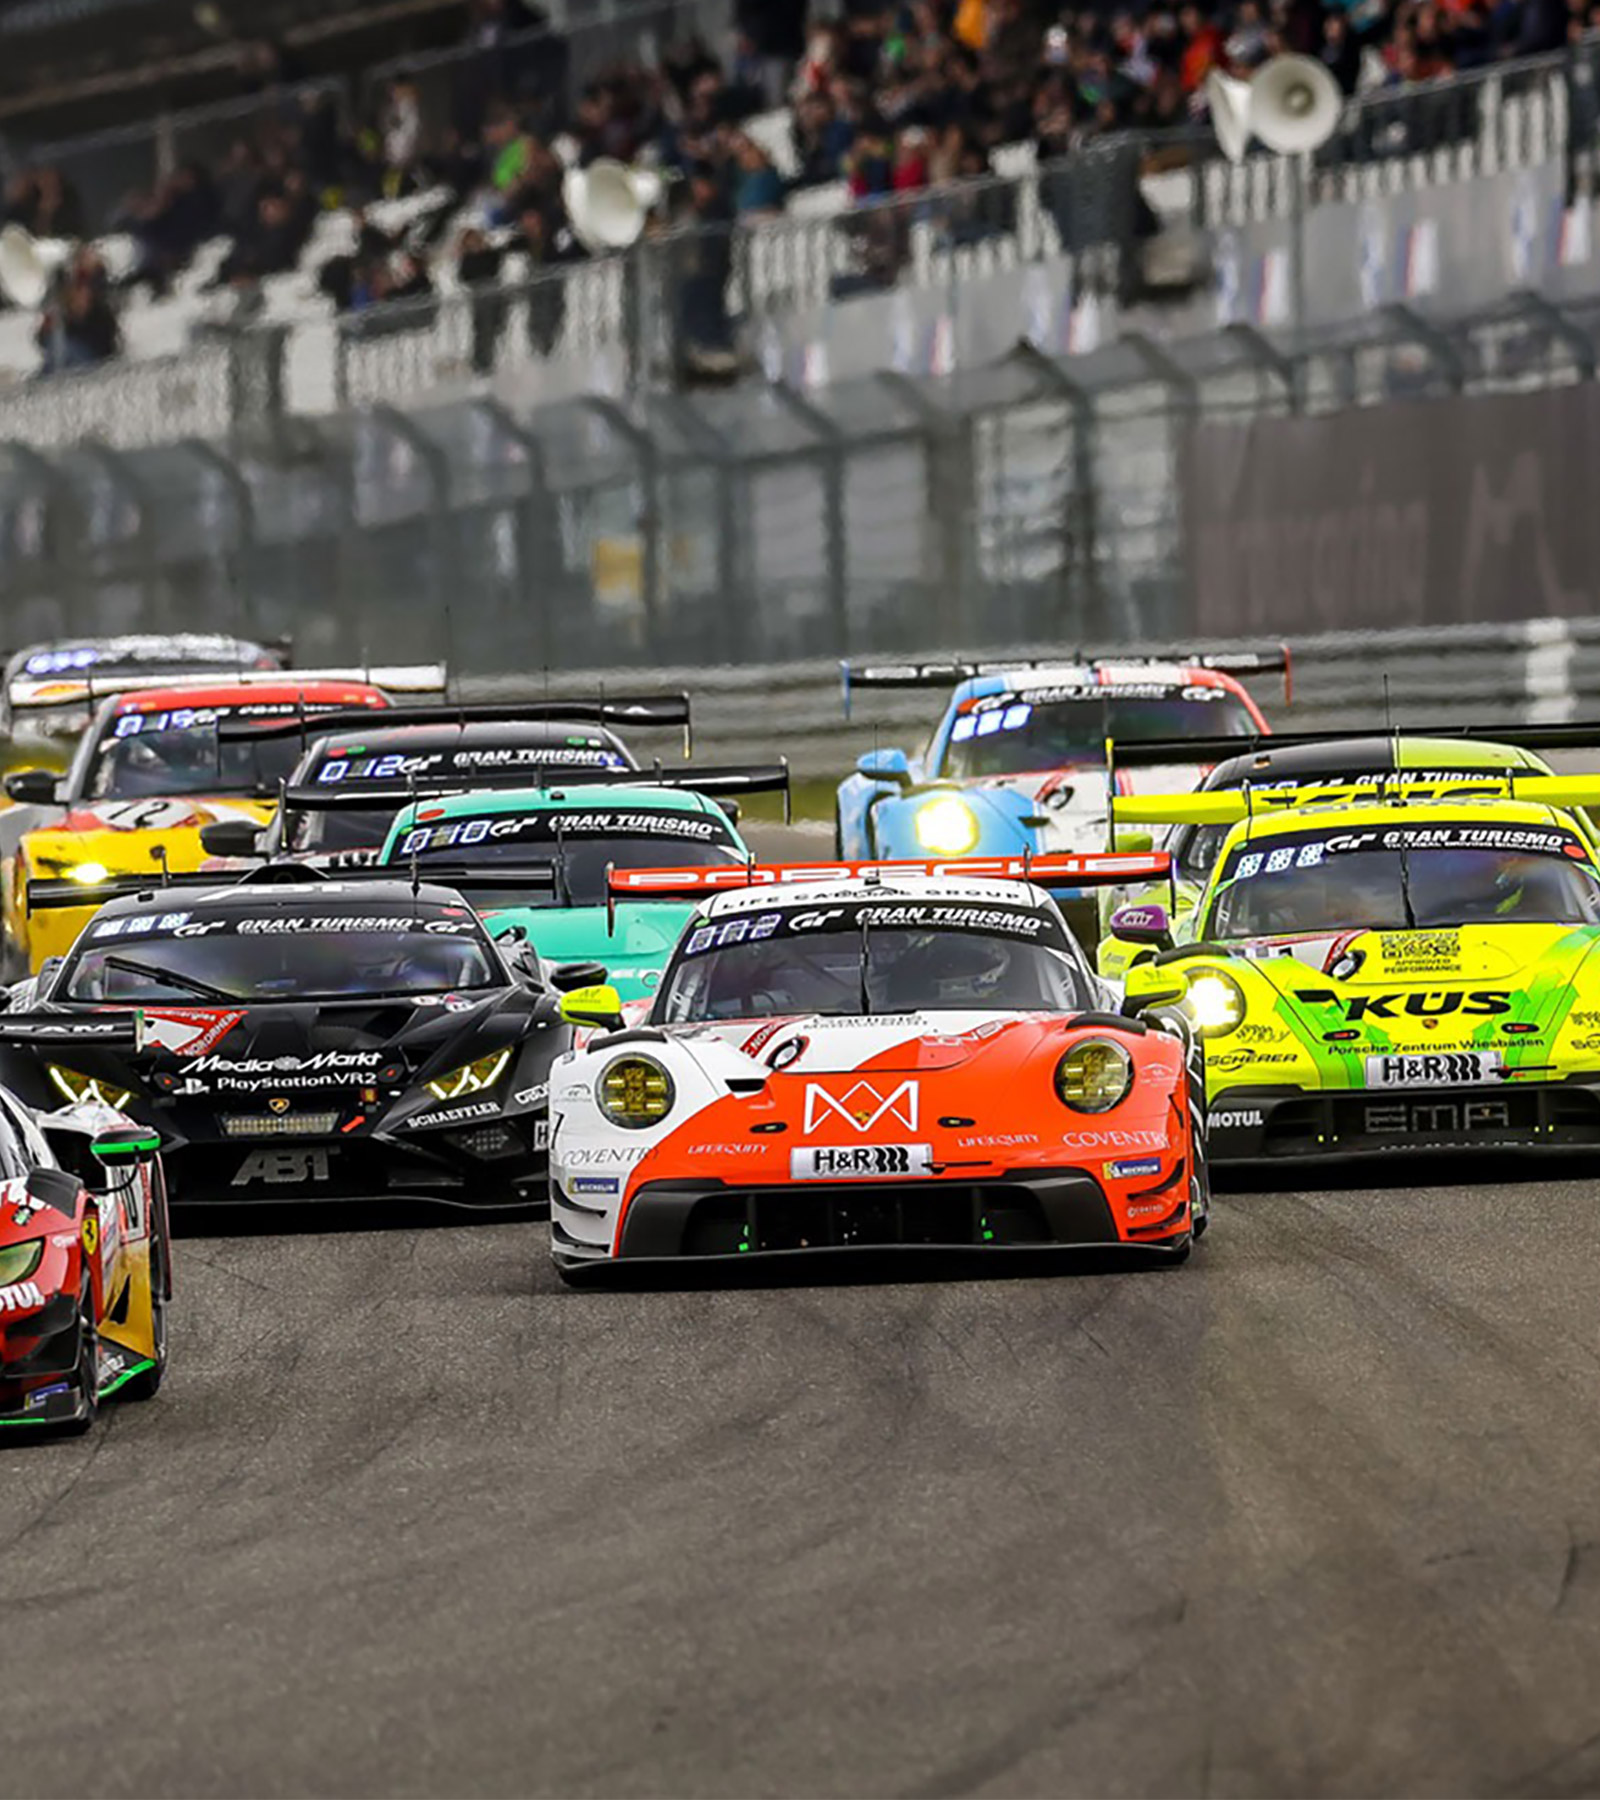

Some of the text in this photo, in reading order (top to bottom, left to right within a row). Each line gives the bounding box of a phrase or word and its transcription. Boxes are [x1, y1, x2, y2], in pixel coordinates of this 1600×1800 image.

[453, 752, 511, 765] GRAN
[517, 749, 609, 763] TURISMO
[1422, 771, 1504, 786] TURISM
[548, 814, 614, 829] GRAN
[618, 815, 714, 835] TURISMO
[1383, 829, 1451, 843] GRAN
[1457, 829, 1563, 847] TURISMO
[629, 856, 1155, 886] PORSCHE
[237, 918, 308, 930] GRAN
[311, 917, 413, 929] TURISMO
[855, 907, 926, 920] GRAN
[932, 908, 1041, 930] TURISMO
[1345, 991, 1512, 1022] KÜS
[1327, 1038, 1545, 1056] Porsche Zentrum Wiesbaden
[179, 1051, 383, 1074] Media Markt
[1382, 1057, 1445, 1081] H&R
[217, 1076, 332, 1092] PlayStation
[407, 1101, 502, 1129] SCHAEFFLER
[1208, 1110, 1264, 1127] MOTUL
[1061, 1130, 1171, 1149] COVENTRY
[231, 1149, 340, 1186] ABT
[814, 1148, 871, 1172] H&R
